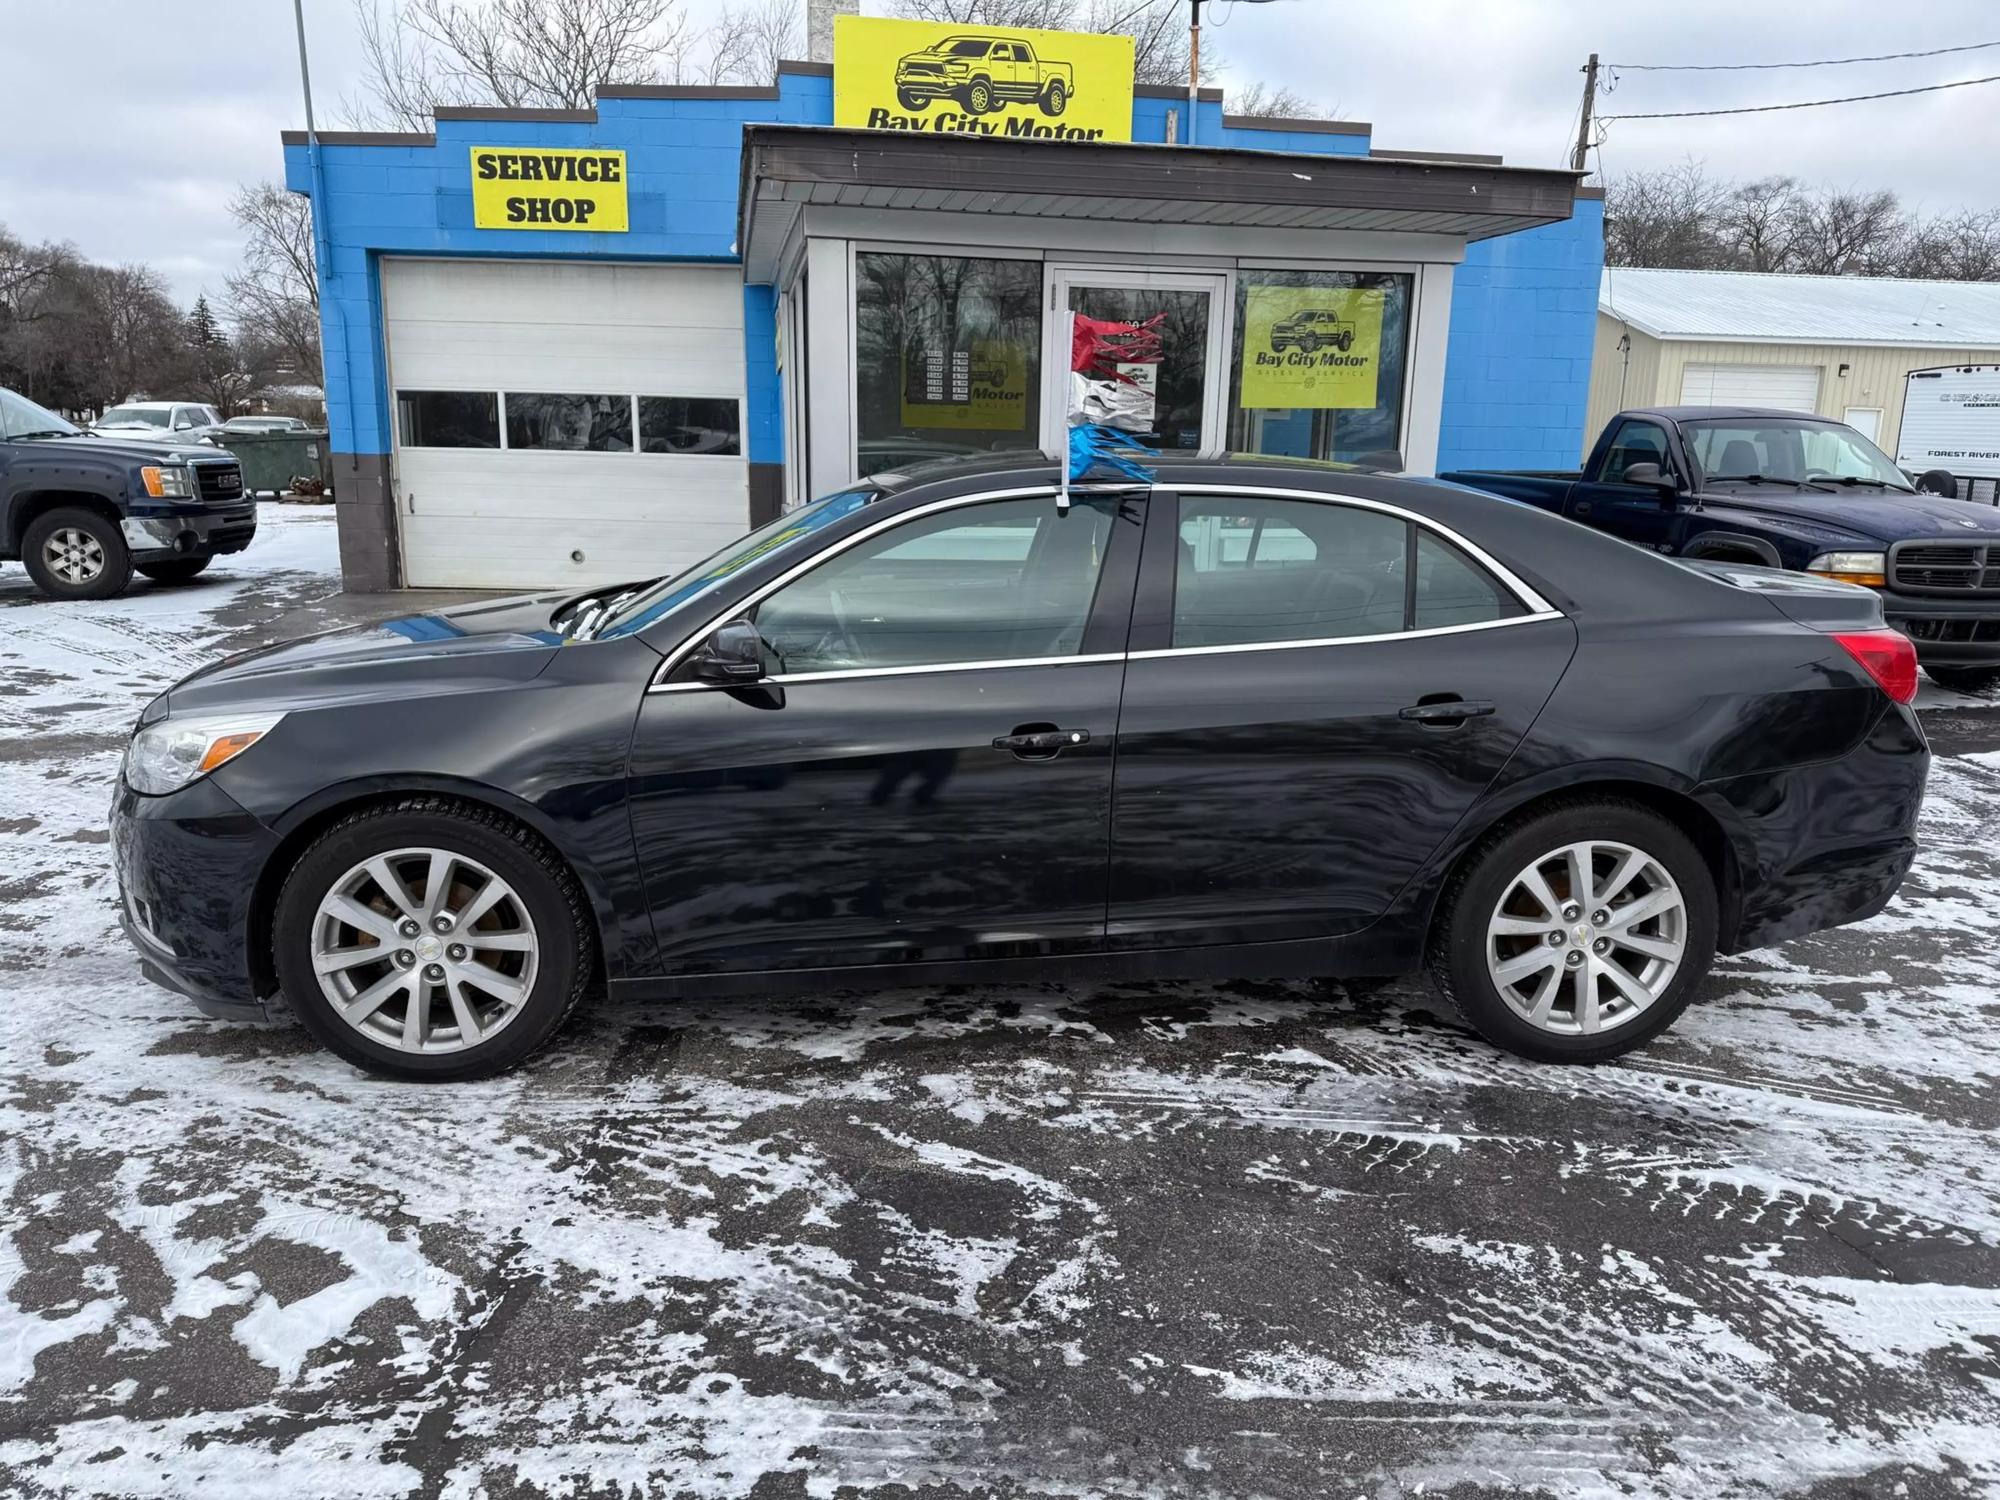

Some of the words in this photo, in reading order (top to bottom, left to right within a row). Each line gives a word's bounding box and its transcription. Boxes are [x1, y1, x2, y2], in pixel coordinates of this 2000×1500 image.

[934, 112, 998, 135] City
[1004, 116, 1103, 141] Motor
[477, 154, 620, 182] SERVICE
[506, 197, 596, 223] SHOP
[1256, 352, 1285, 368] Bay
[1287, 352, 1318, 369] City
[1320, 353, 1368, 366] Motor
[972, 387, 1024, 400] Motor
[1928, 450, 1967, 458] FOREST
[1968, 451, 2000, 459] RIVER
